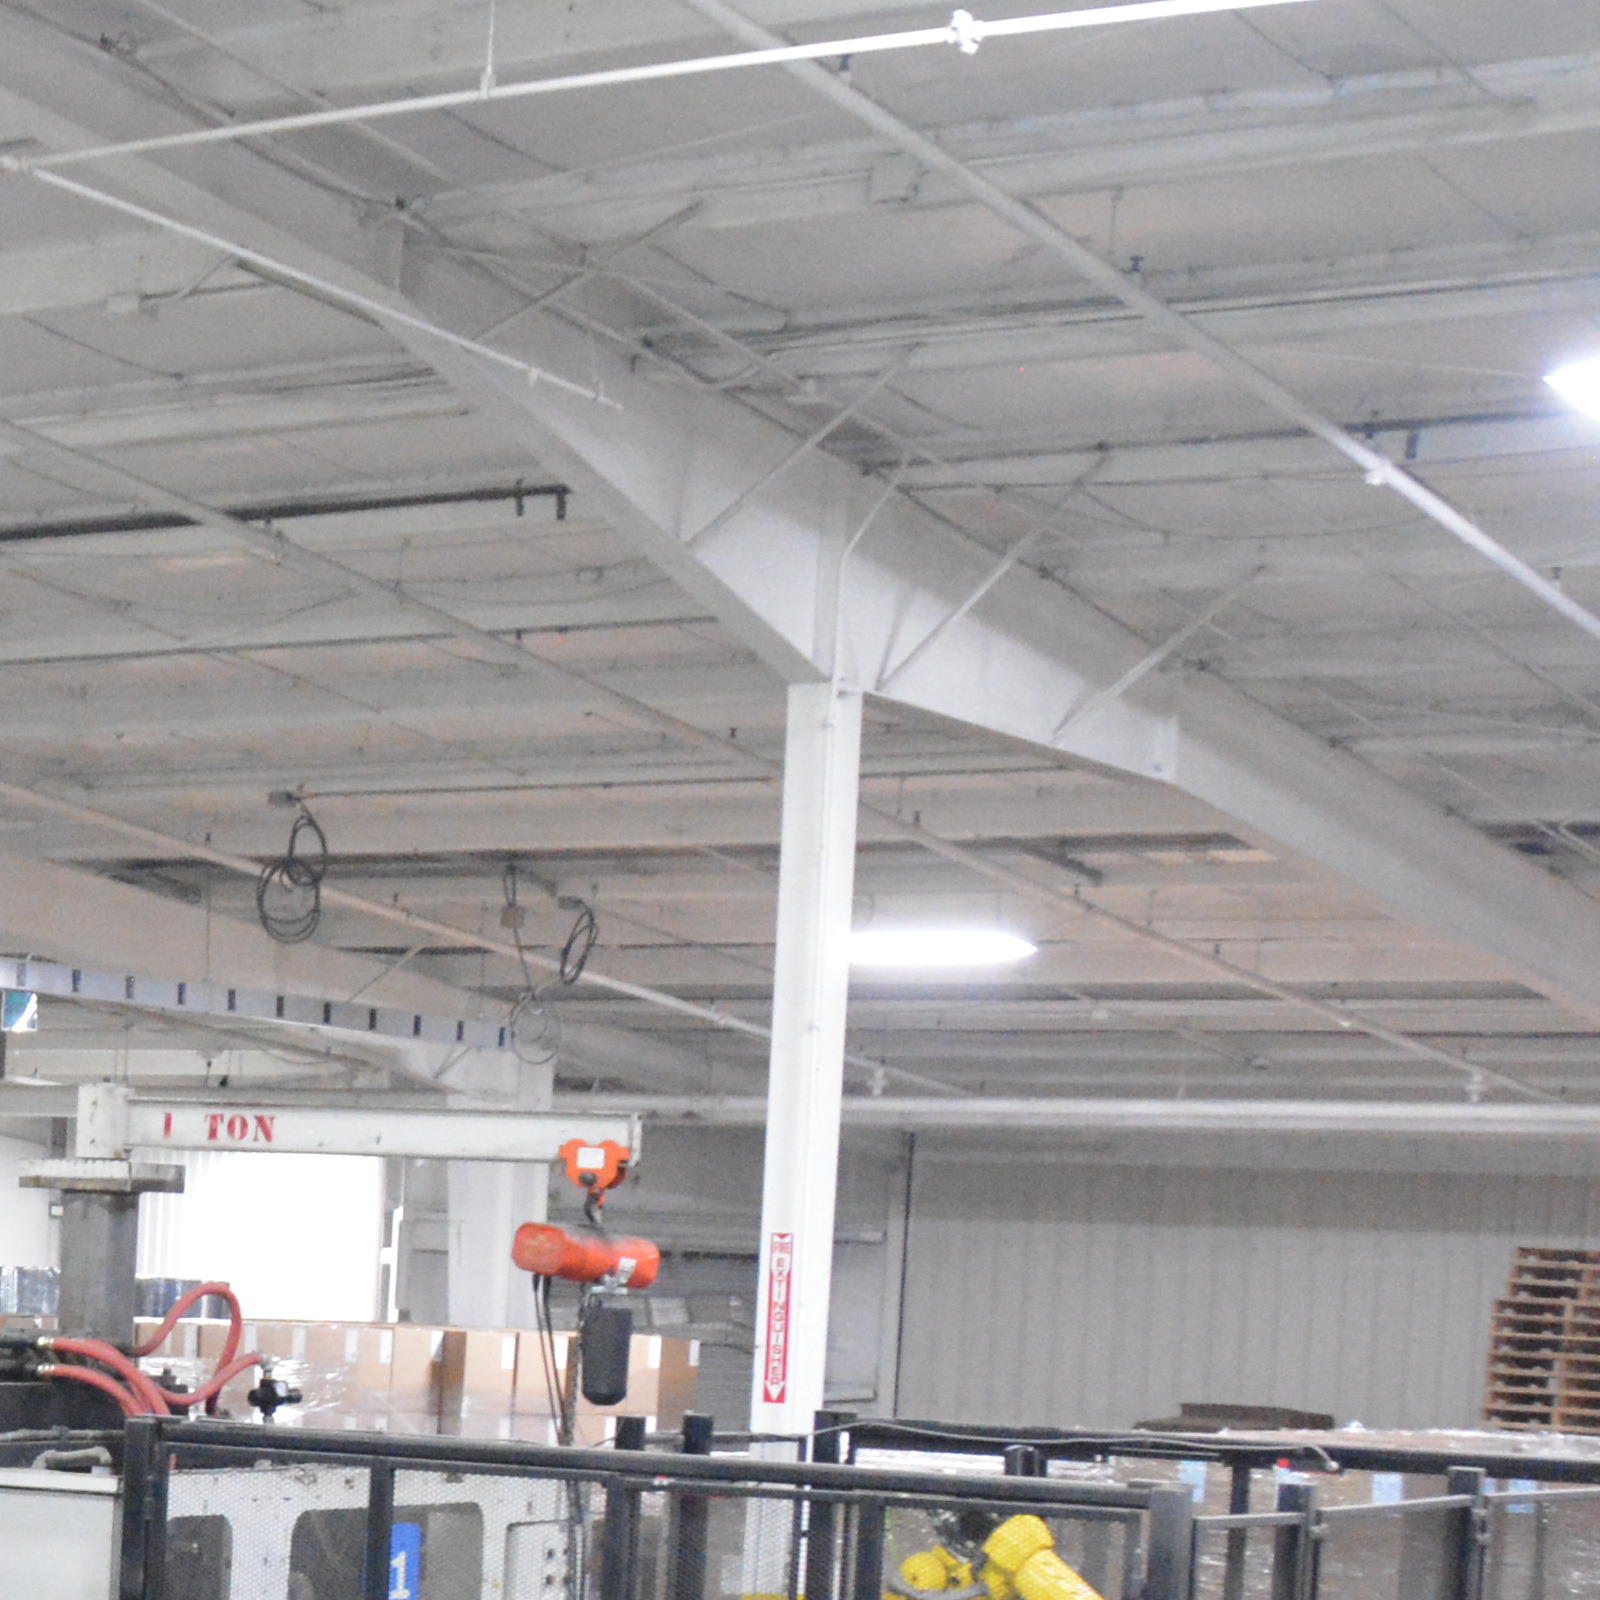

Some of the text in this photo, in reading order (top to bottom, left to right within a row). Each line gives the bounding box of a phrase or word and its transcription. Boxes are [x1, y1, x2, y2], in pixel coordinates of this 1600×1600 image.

[204, 1113, 276, 1142] TON
[770, 1257, 787, 1386] EXTINGUISHER
[390, 1550, 411, 1600] 1
